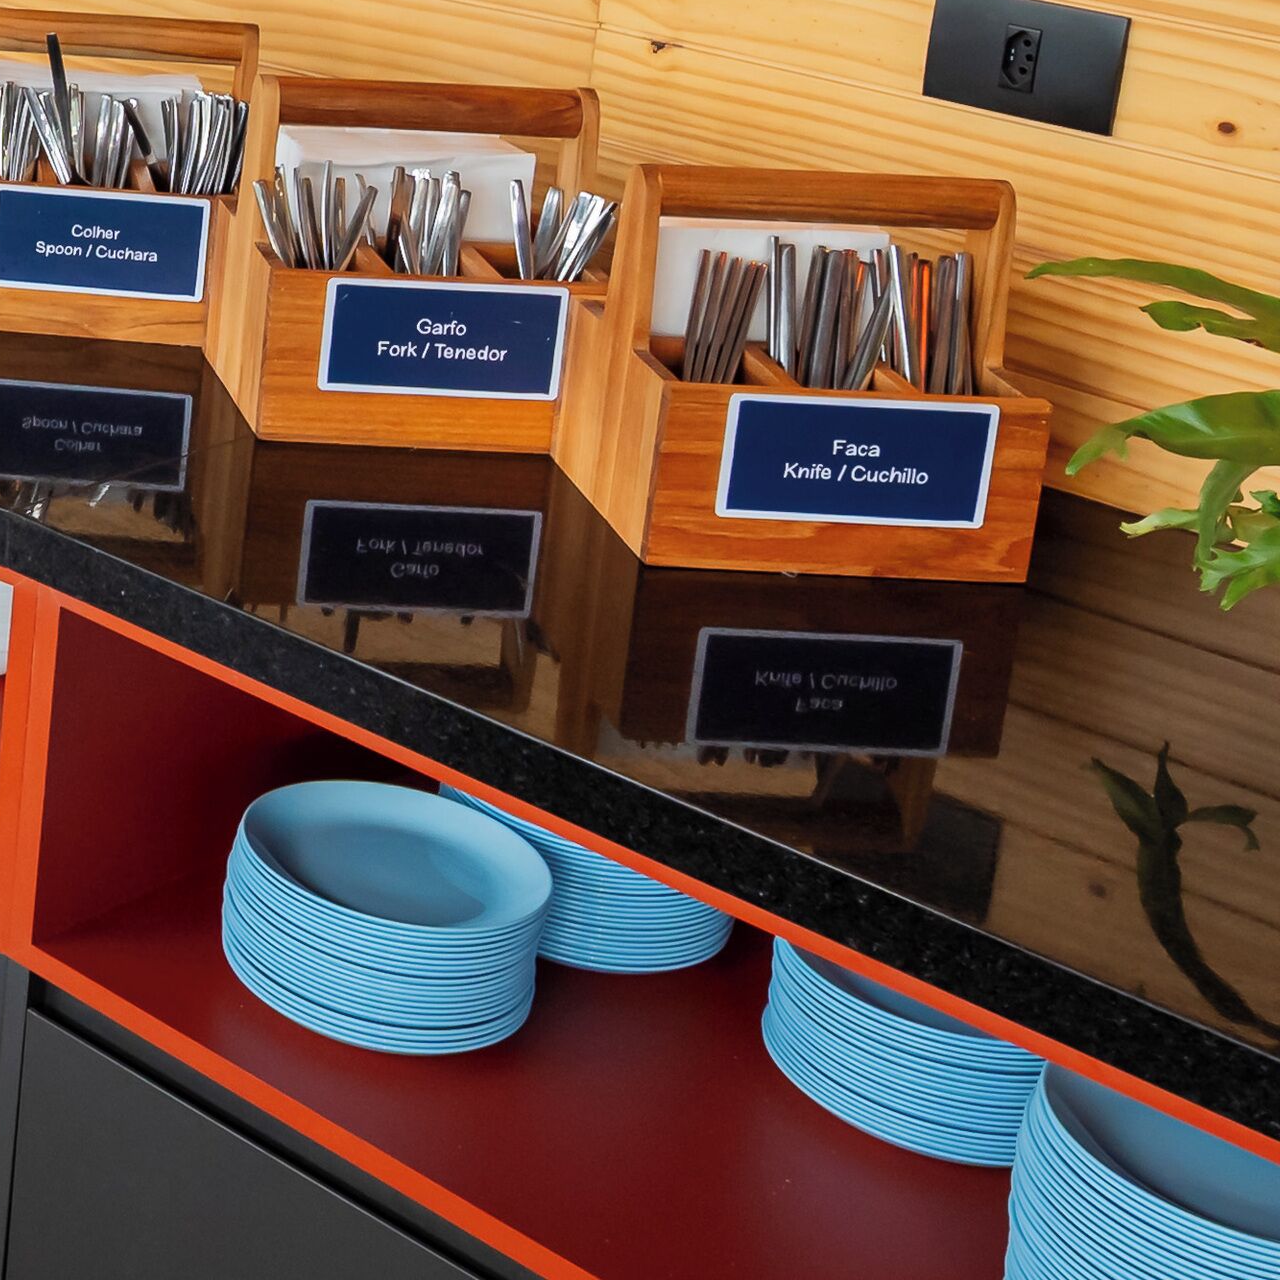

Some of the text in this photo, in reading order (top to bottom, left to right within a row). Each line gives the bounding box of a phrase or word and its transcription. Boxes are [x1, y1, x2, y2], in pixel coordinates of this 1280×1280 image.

[71, 224, 120, 240] Colher
[35, 240, 158, 262] Spoon / Cuchara
[416, 318, 467, 336] Garfo
[377, 341, 508, 362] Fork / Tenedor
[832, 439, 881, 457] Faca
[783, 462, 929, 485] Knife / Cuchillo
